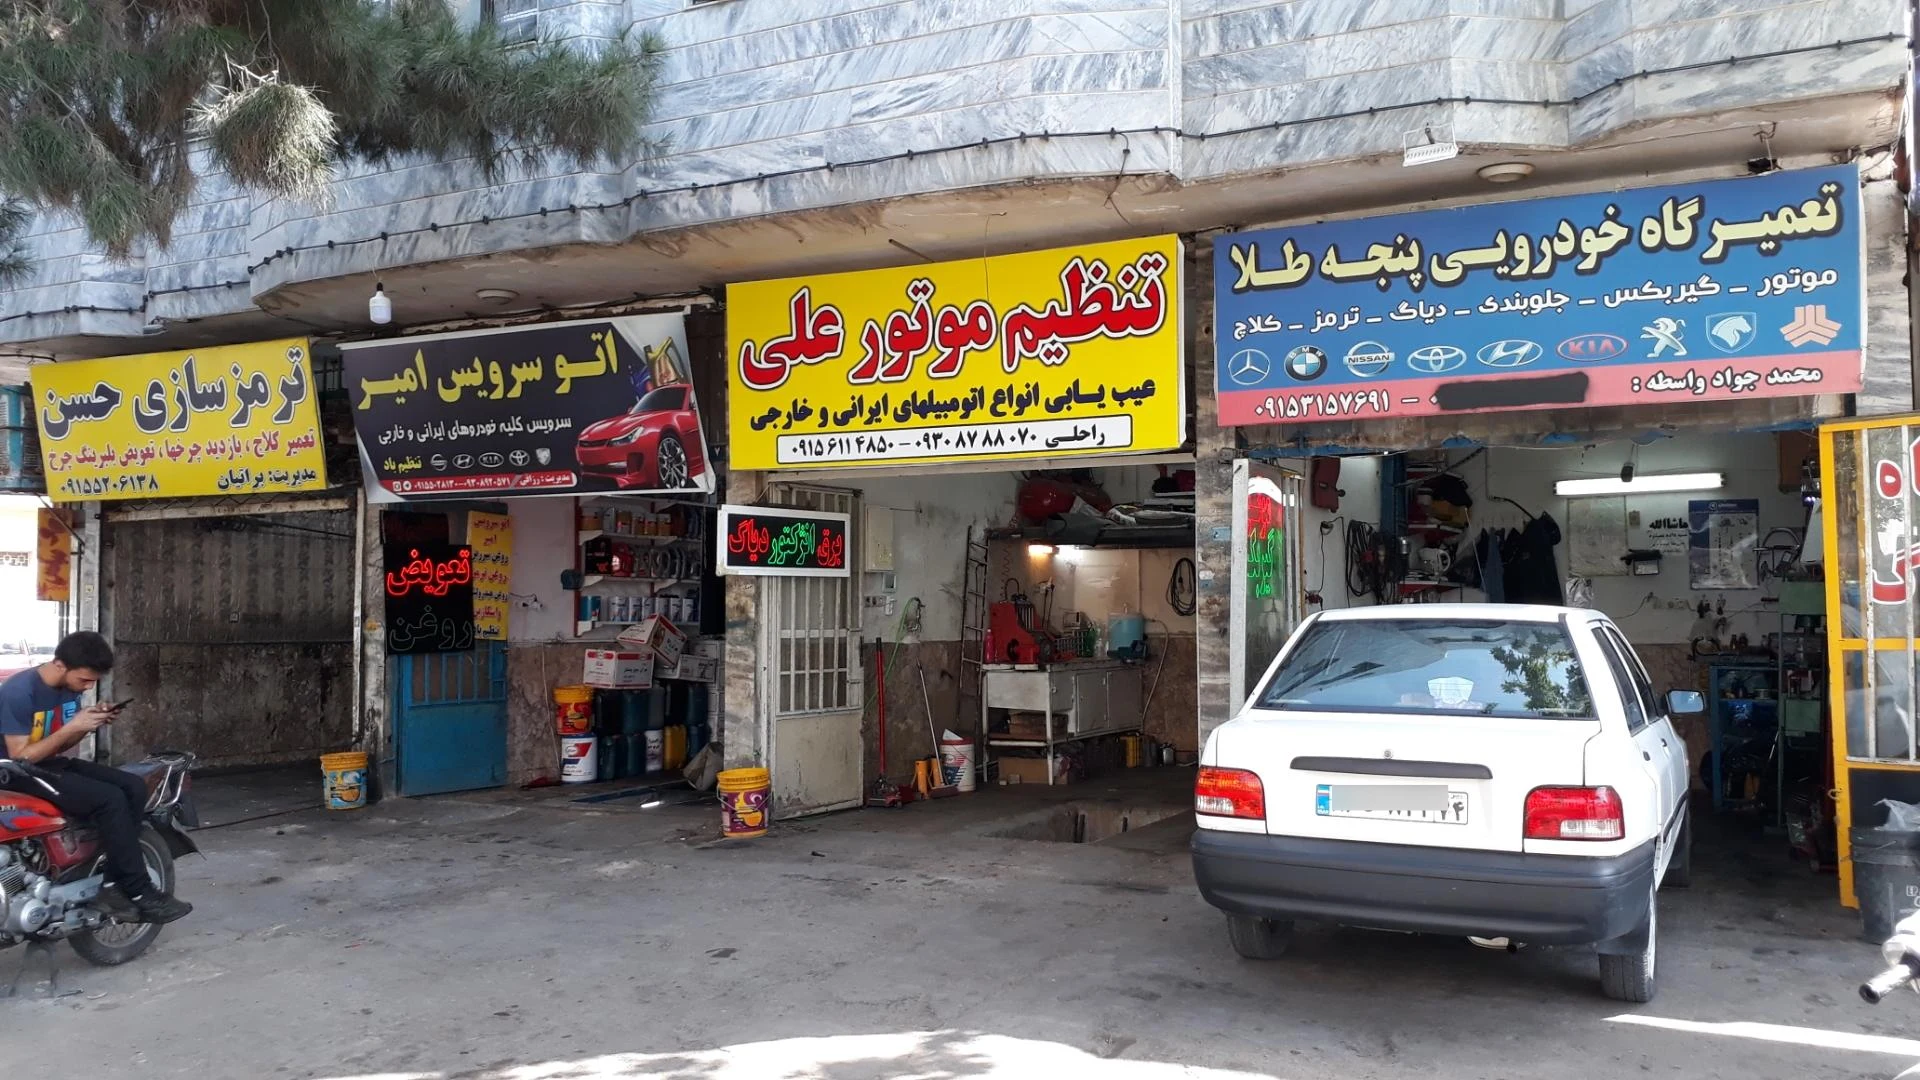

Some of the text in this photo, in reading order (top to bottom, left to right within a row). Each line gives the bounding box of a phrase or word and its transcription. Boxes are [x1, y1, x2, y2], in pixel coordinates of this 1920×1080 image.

[1429, 204, 1630, 284] خودرویی
[1228, 238, 1312, 290] طلا
[1319, 234, 1421, 289] پنجه
[1603, 273, 1721, 308] گیربکس
[1756, 267, 1838, 297] موتور
[1388, 300, 1447, 325] دیاگ
[1477, 287, 1571, 317] جلوبندی
[739, 252, 1169, 390] تنظیم موتور علی
[1232, 313, 1283, 340] کلاچ
[1310, 306, 1360, 333] ترمز
[1347, 353, 1390, 364] NISSAN
[1568, 338, 1616, 355] KIA
[357, 329, 620, 410] اتو سرویس امیر
[1645, 368, 1707, 396] واسطه
[1711, 366, 1761, 393] جواد
[1765, 366, 1823, 386] محمد
[41, 380, 123, 440] حسن
[750, 378, 1156, 431] عیب یابی انواع اتومبیلهای ایرانی و خارجی
[1254, 388, 1390, 419] ۰۹۱۵۳۱۵۷۶۹۱
[286, 428, 316, 457] تعمیر
[378, 415, 572, 446] سرویس کلیه خودروهای ایرانی و خارجی
[119, 440, 155, 467] تعویض
[206, 434, 242, 461] بازدید
[728, 518, 843, 567] برق انژکتور دیاگ
[387, 548, 471, 596] تعویض
[389, 604, 474, 652] روغن
